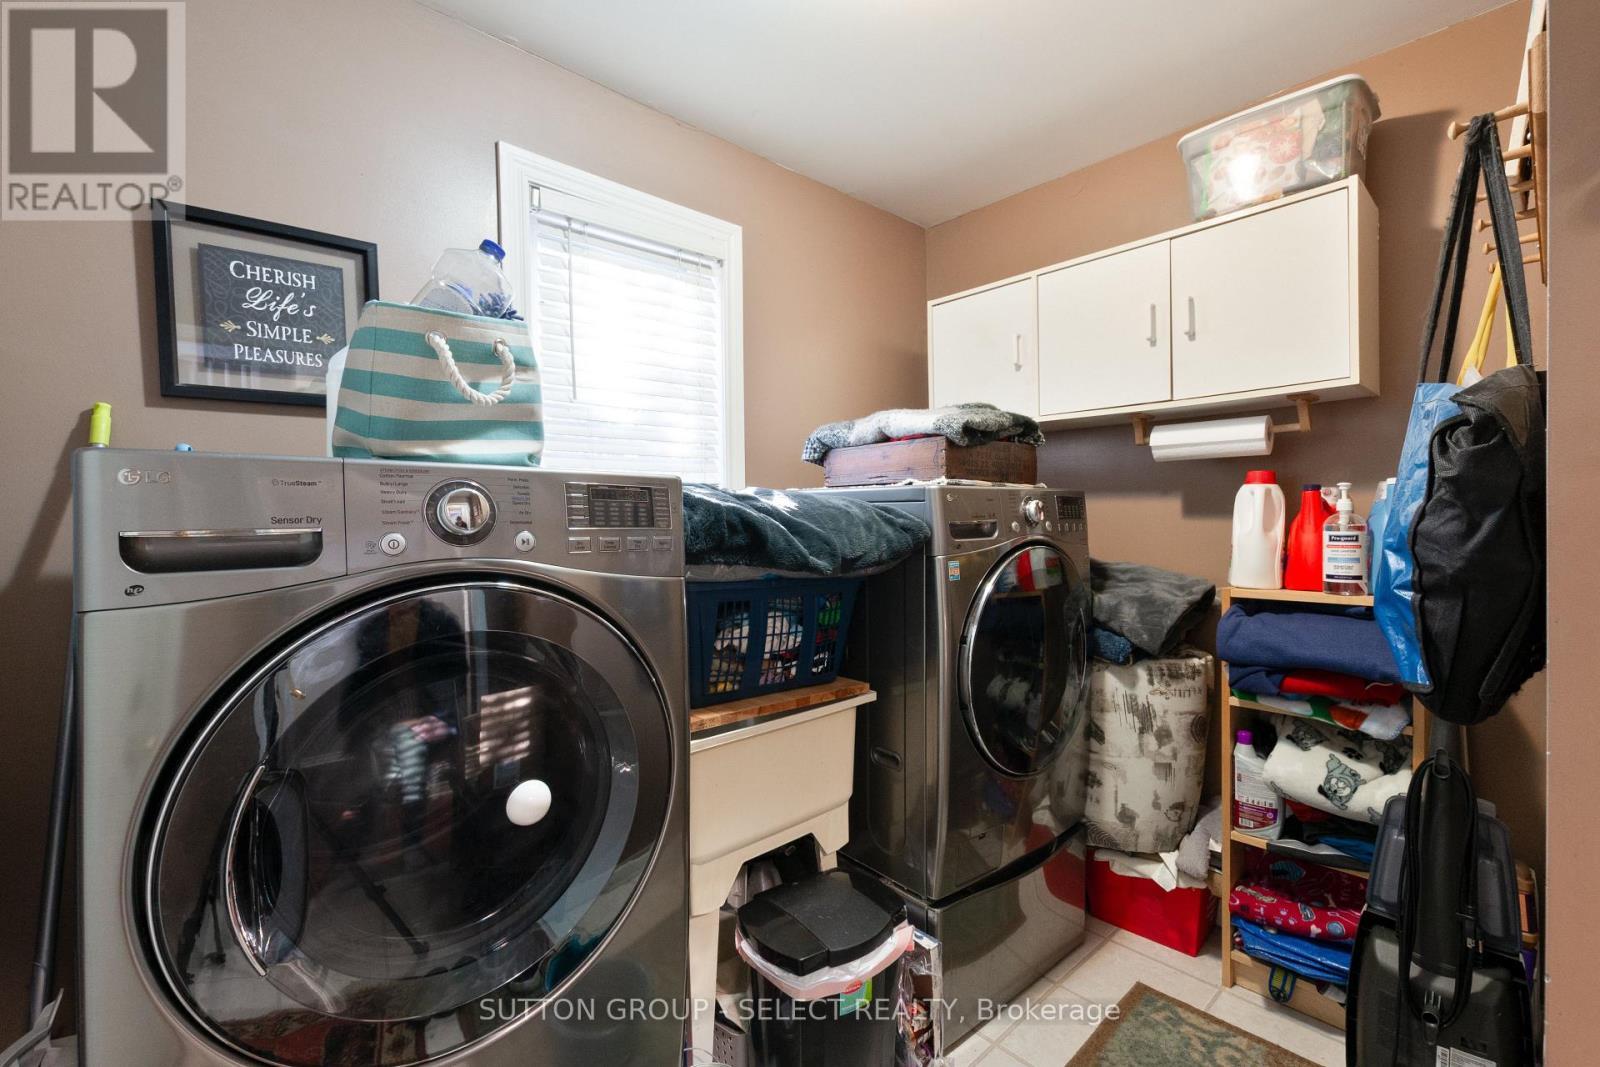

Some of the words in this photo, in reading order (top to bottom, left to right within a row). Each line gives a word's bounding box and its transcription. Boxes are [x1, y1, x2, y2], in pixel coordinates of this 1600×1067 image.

[229, 260, 317, 290] CHERISH
[242, 287, 317, 321] Life's
[246, 320, 313, 344] SIMPLE
[233, 343, 324, 368] PLEASURES
[271, 516, 304, 525] Sensor
[306, 516, 323, 525] Dry
